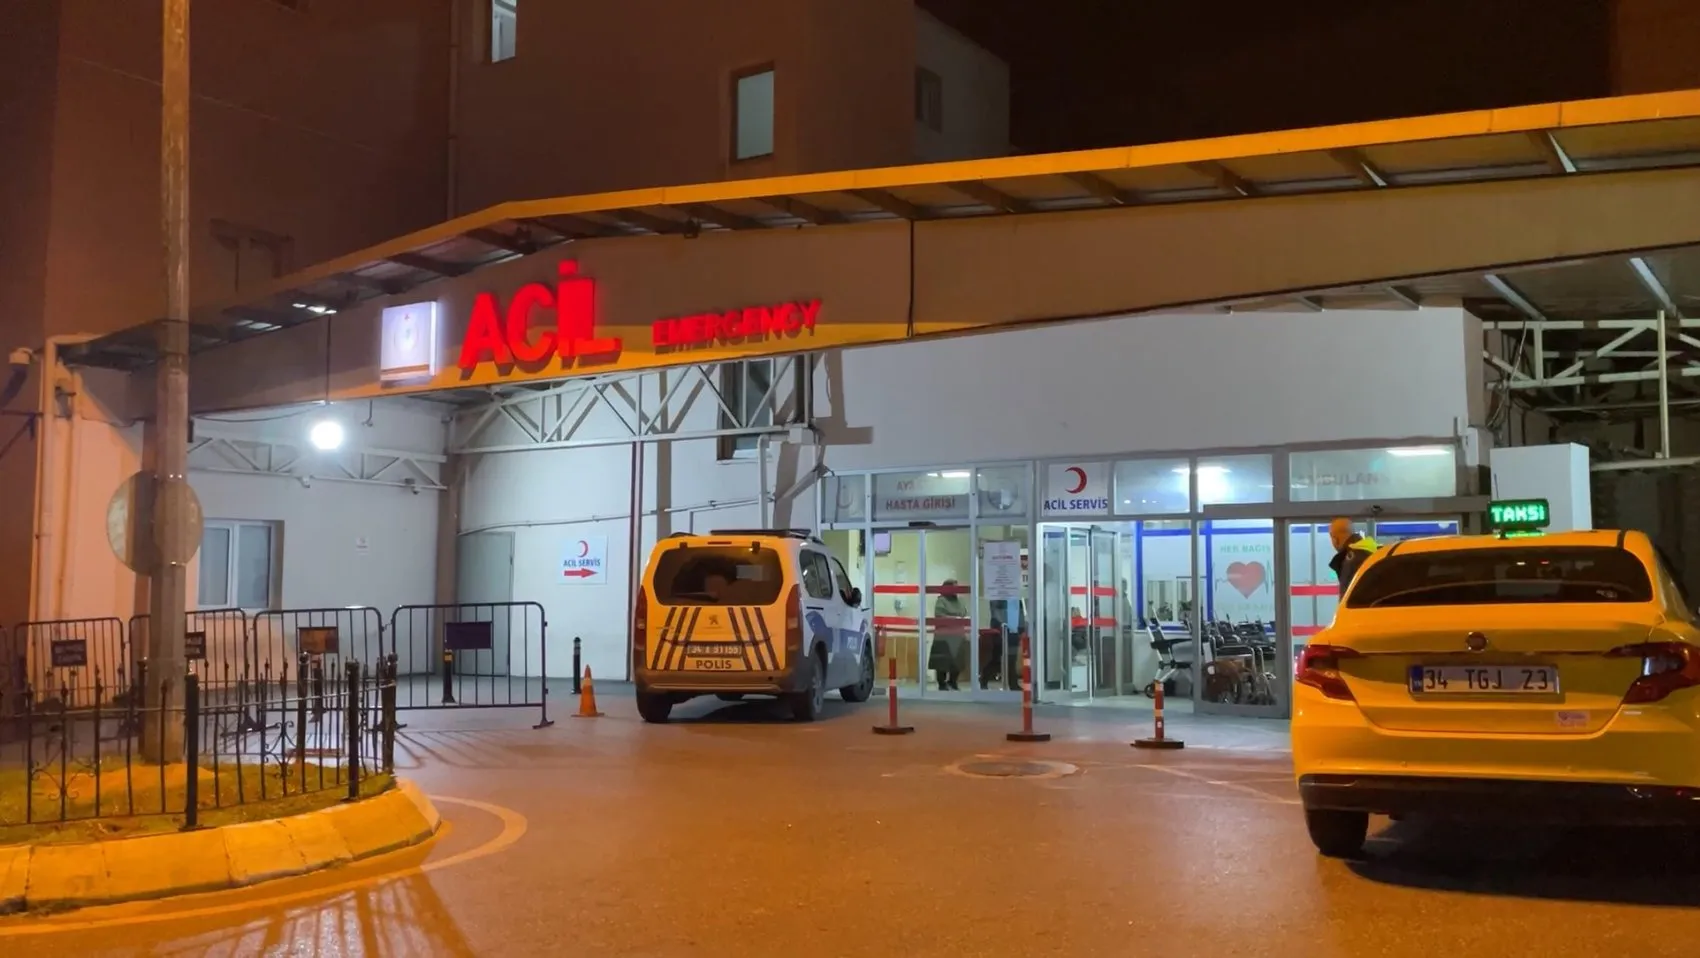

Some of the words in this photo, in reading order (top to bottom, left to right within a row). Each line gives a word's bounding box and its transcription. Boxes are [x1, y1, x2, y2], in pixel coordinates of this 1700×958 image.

[458, 259, 622, 369] ACİL
[652, 299, 822, 346] EMERGENCY
[885, 499, 920, 511] HASTA
[1044, 498, 1067, 510] ACİL
[1069, 497, 1108, 509] SERVİS
[696, 659, 732, 669] POLİS
[1425, 669, 1448, 689] 34
[1465, 669, 1503, 689] TGJ
[1521, 669, 1548, 689] 23
